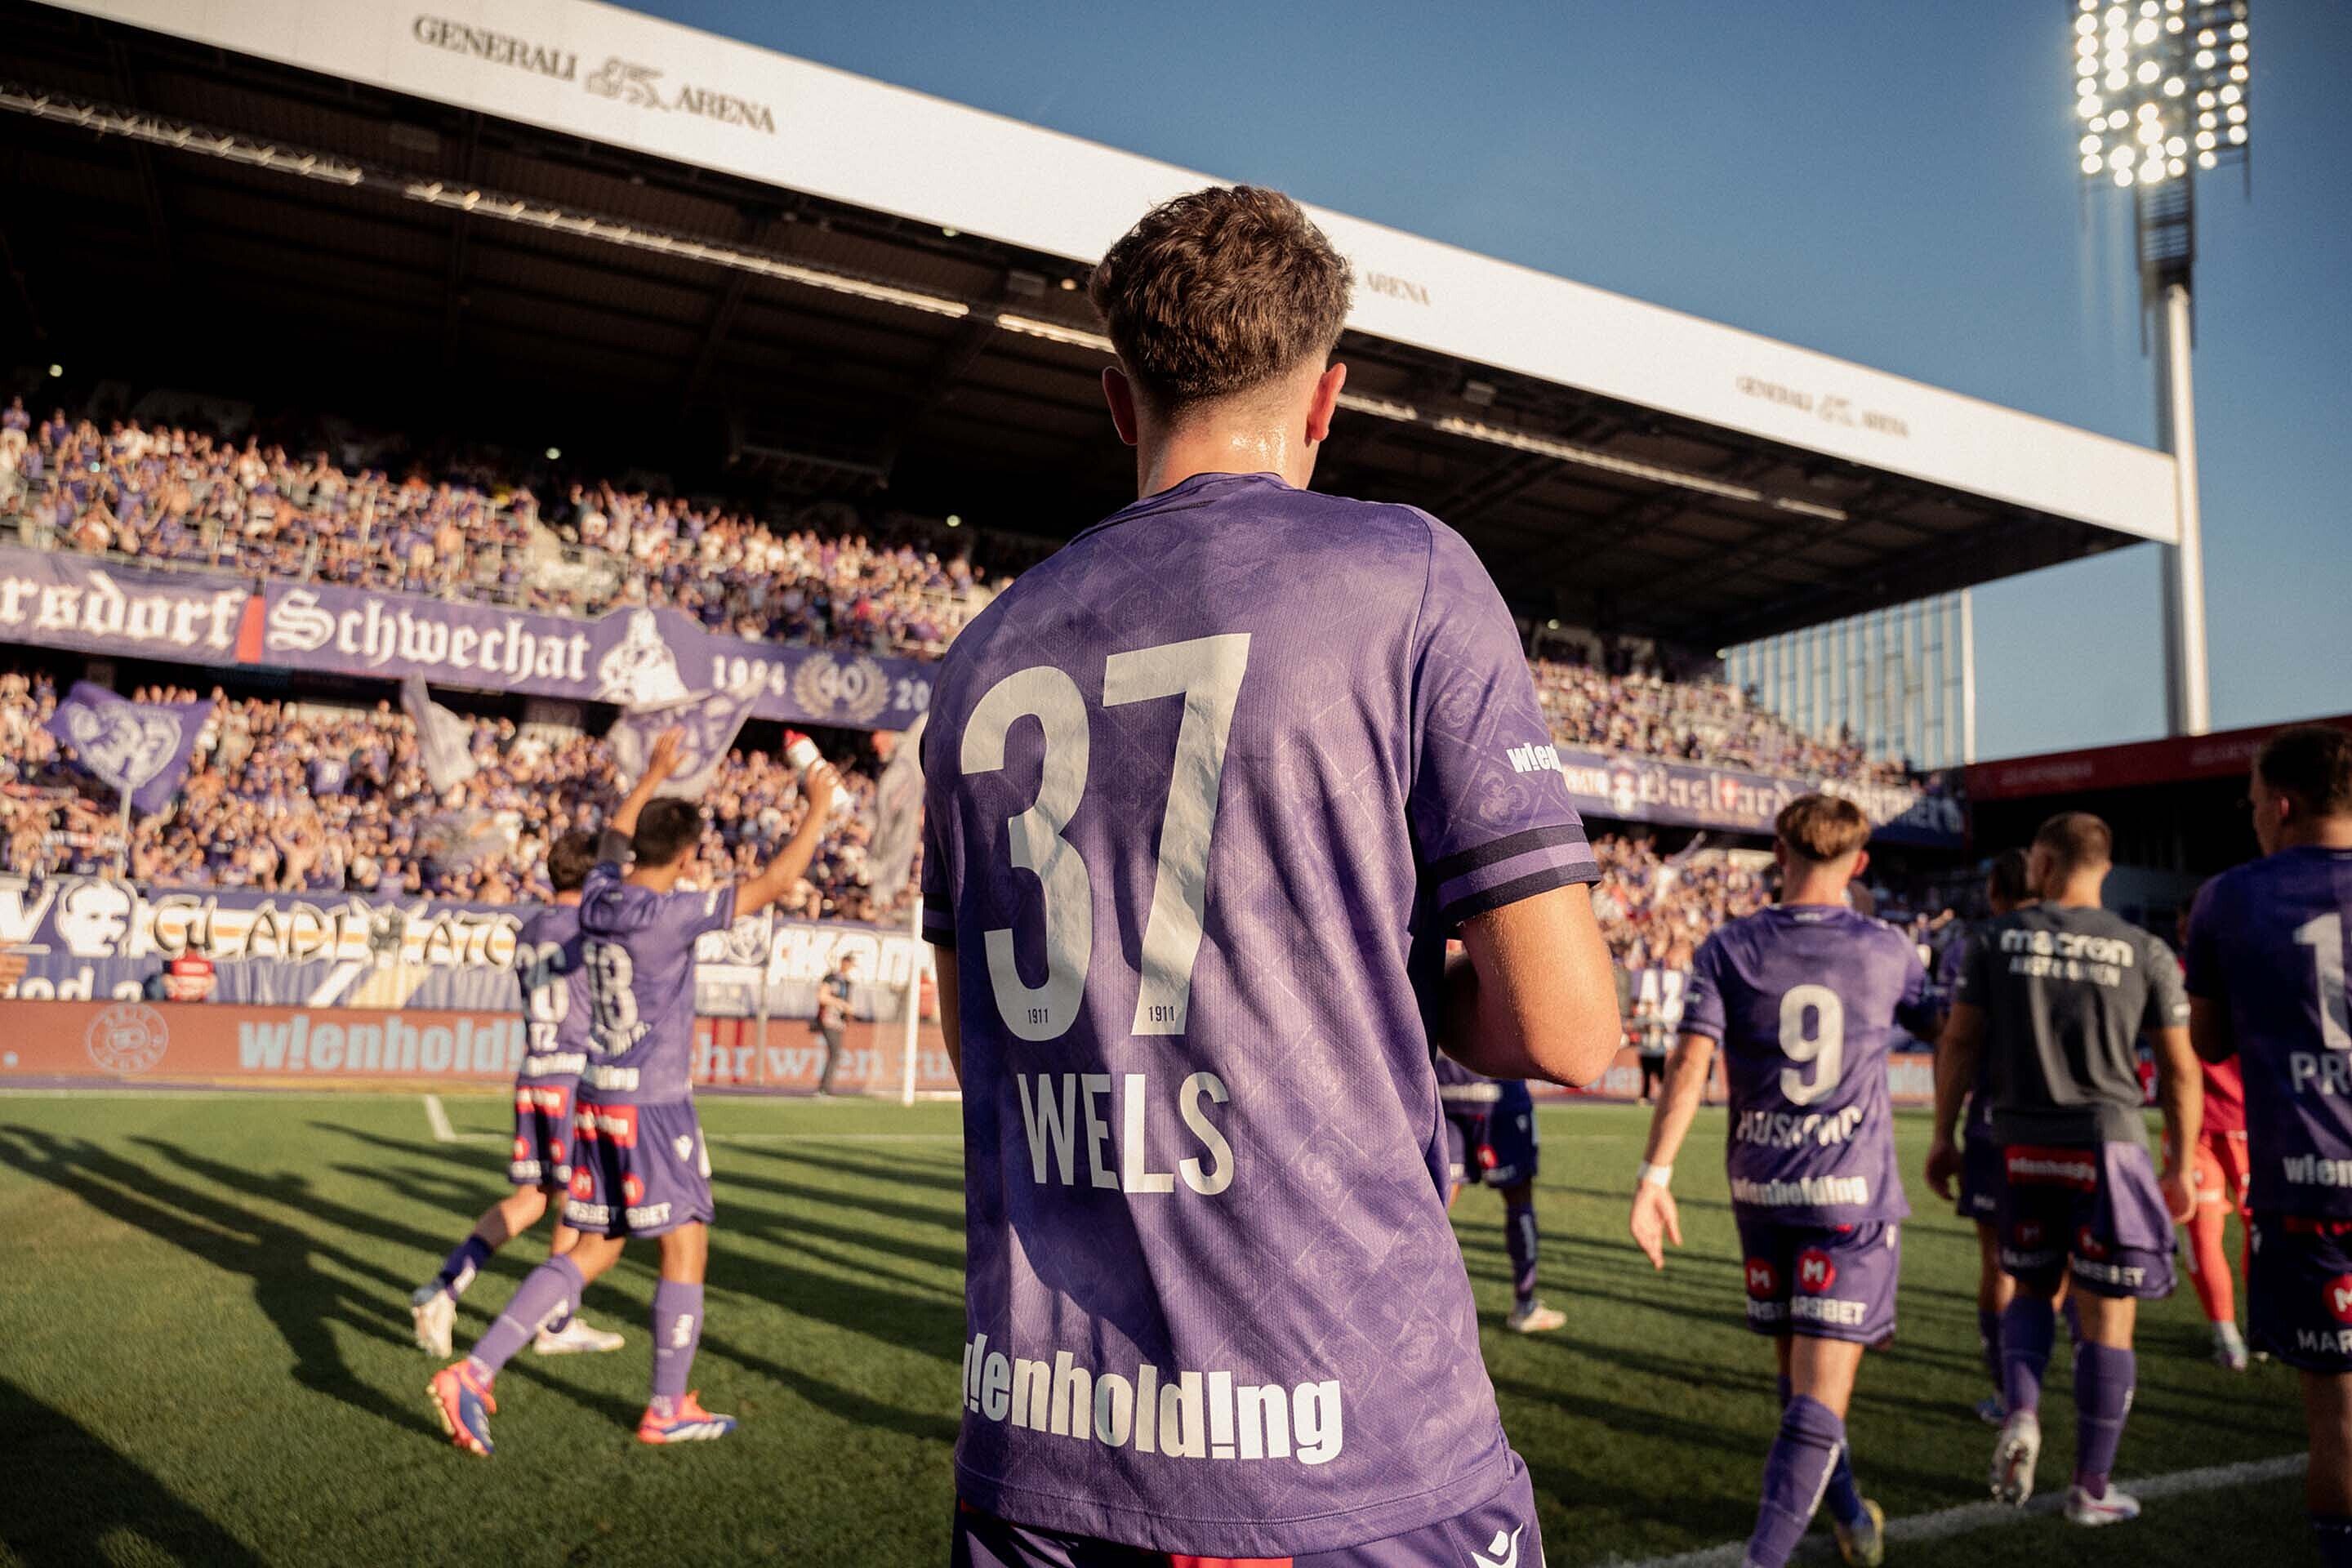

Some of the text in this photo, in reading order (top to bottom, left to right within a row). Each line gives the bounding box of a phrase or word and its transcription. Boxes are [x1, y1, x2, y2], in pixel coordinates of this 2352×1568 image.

[412, 14, 777, 135] GENERALI ARENA
[1365, 273, 1432, 307] ARENA
[266, 587, 590, 684] Schwechat
[895, 679, 930, 712] 20
[960, 632, 1252, 1041] 37
[1027, 1008, 1049, 1025] 1911
[1148, 1005, 1175, 1022] 1911
[2292, 912, 2352, 1049] 1
[1778, 984, 1844, 1107] 9
[2290, 1051, 2352, 1094] PR
[1018, 1071, 1235, 1196] WELS
